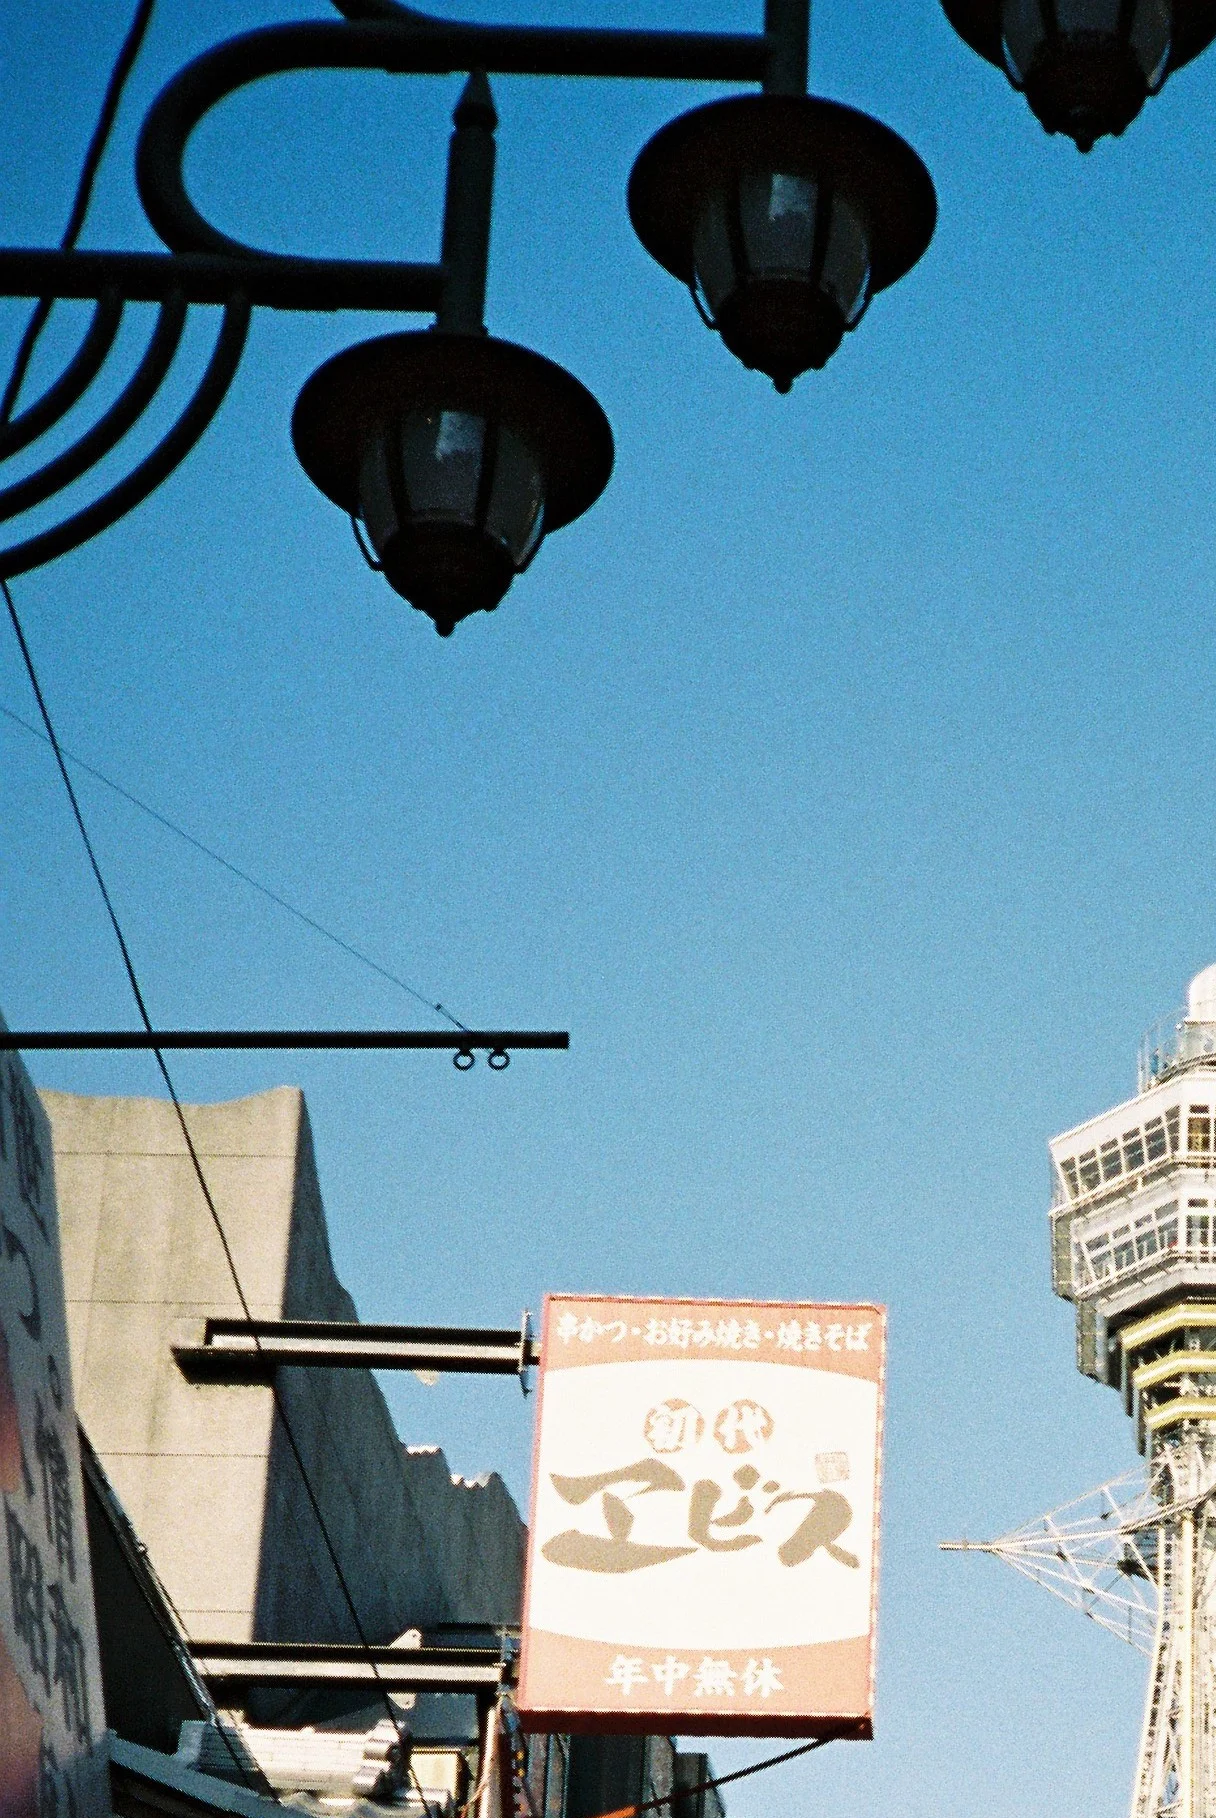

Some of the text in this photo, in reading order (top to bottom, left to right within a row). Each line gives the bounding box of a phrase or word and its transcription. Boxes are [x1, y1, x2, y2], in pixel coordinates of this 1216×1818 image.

[540, 1457, 860, 1574] エビス
[606, 1653, 784, 1698] 年中無休
